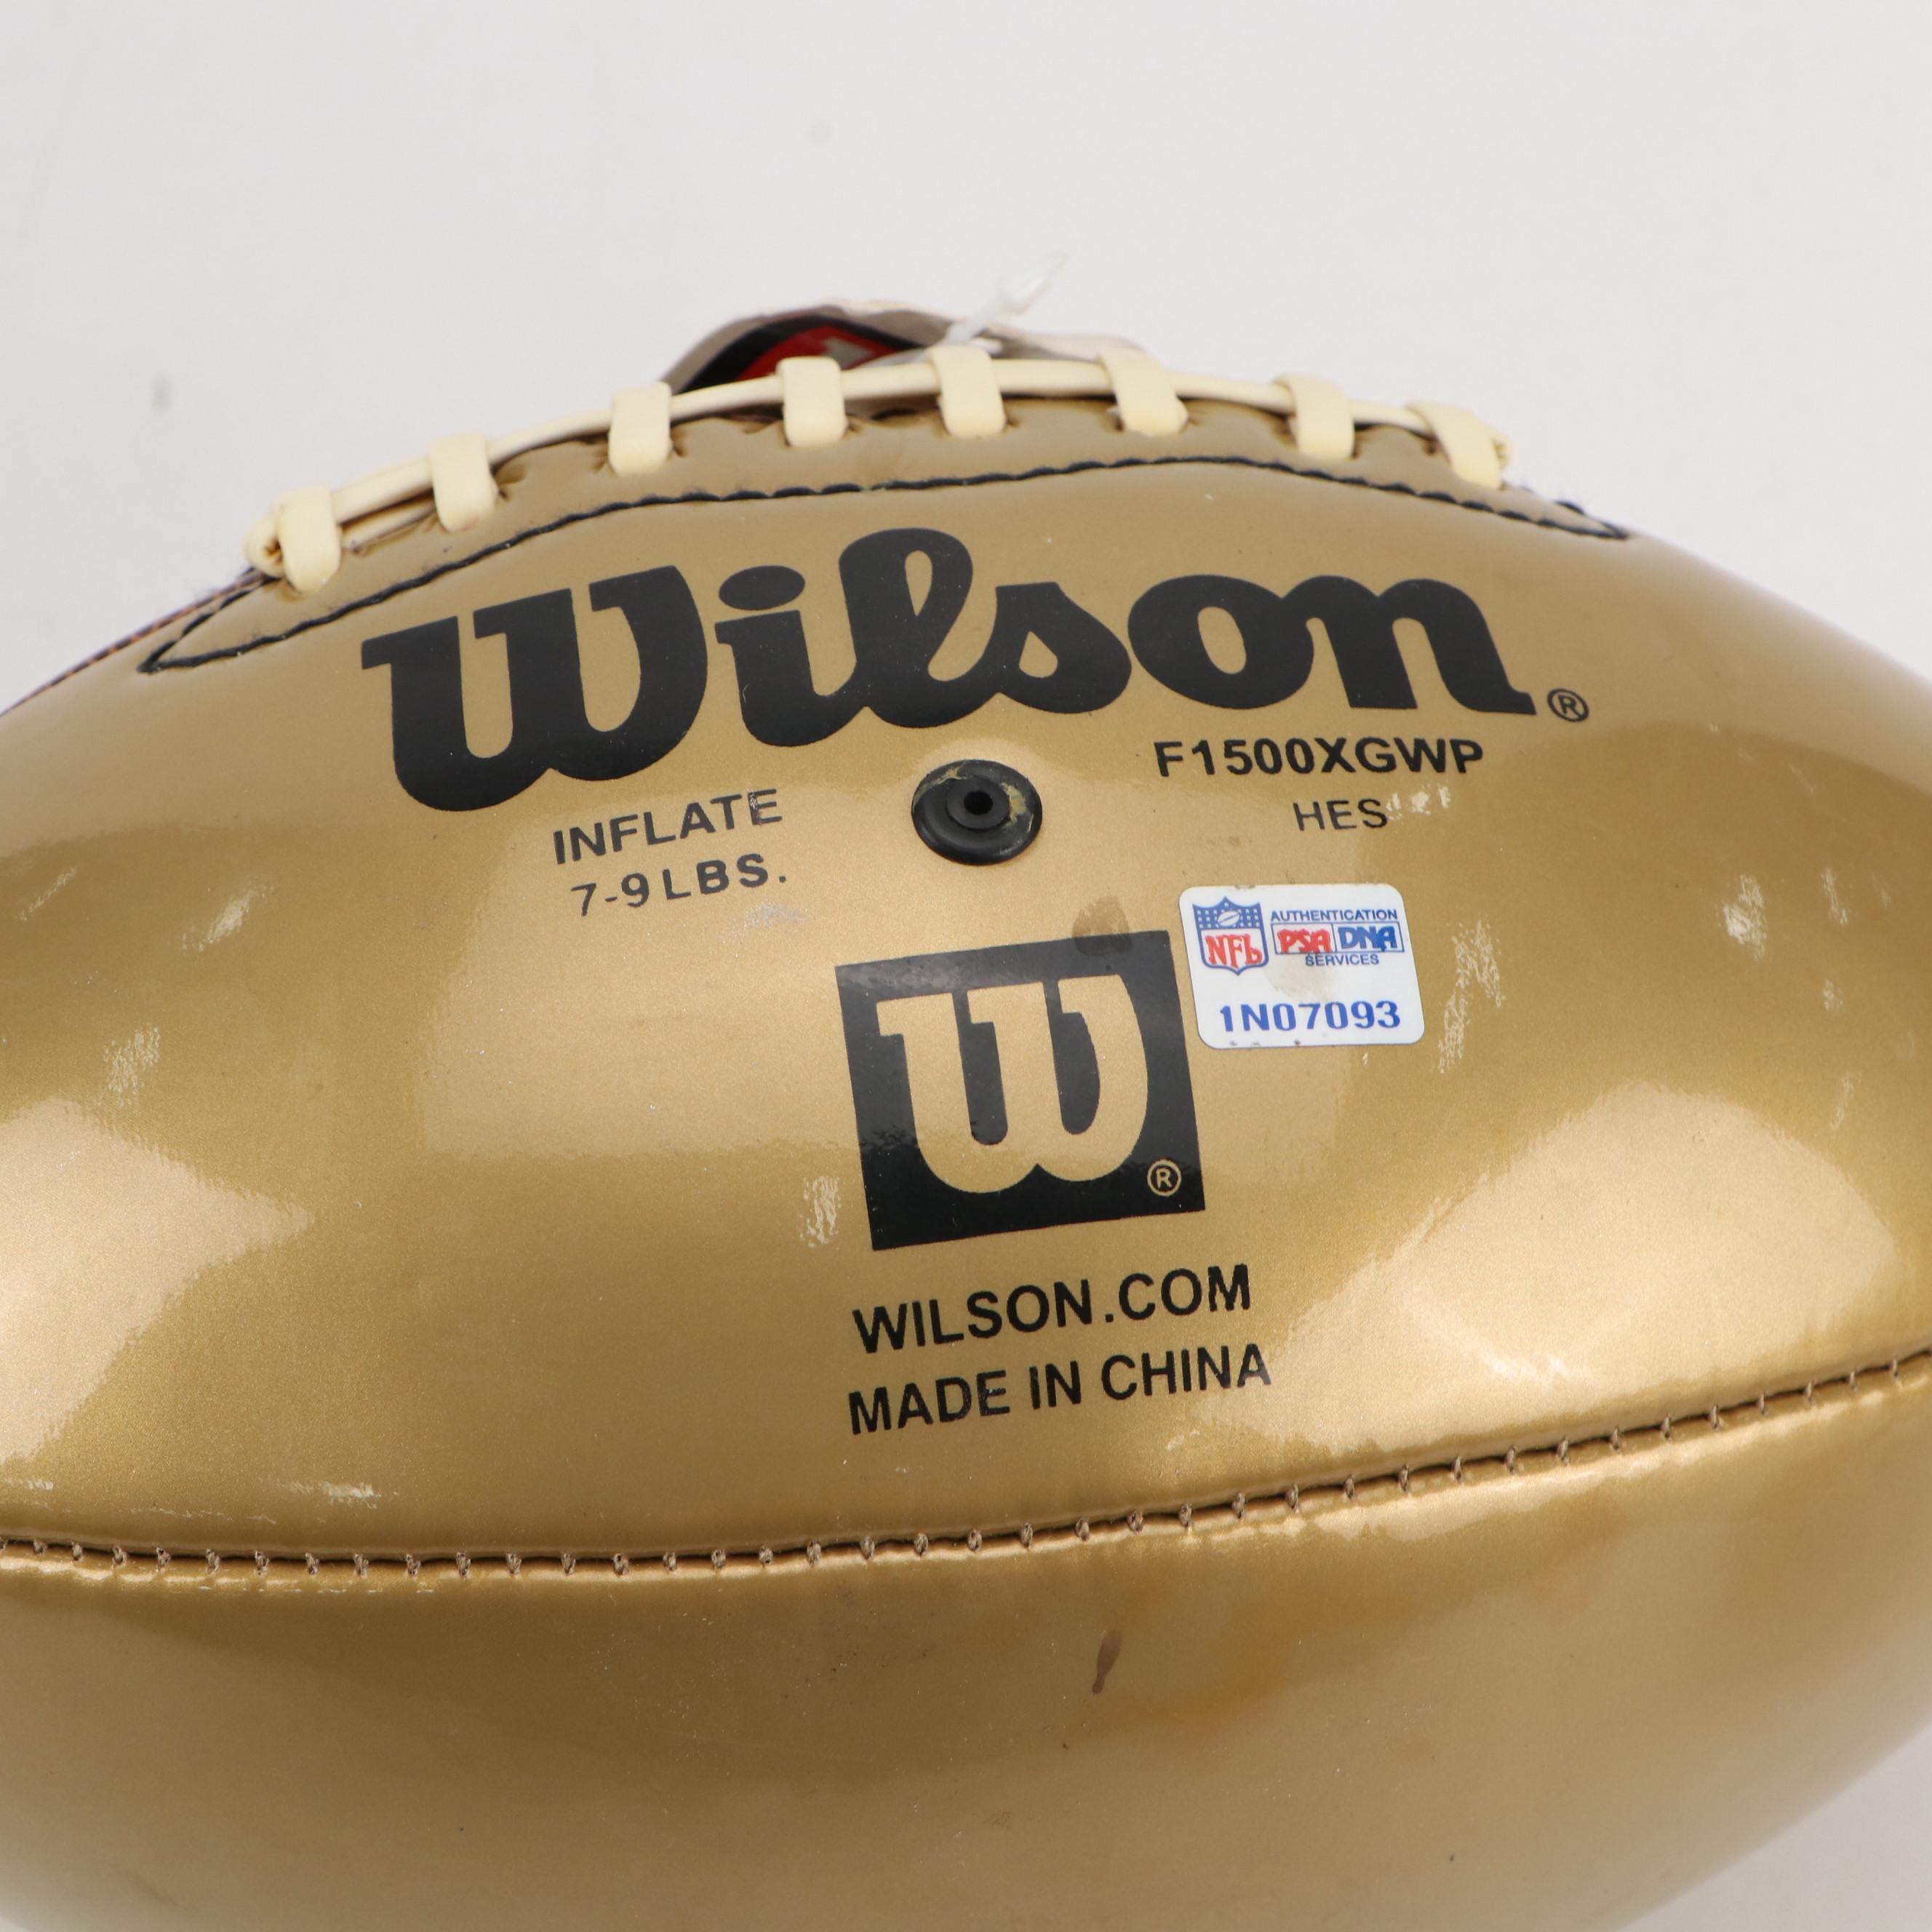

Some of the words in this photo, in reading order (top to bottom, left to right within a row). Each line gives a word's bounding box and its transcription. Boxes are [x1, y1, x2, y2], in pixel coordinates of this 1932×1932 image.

[362, 527, 1535, 811] Wilson
[1154, 736, 1484, 777] F1500XGWP
[553, 789, 783, 865] INFLATE
[1293, 799, 1389, 831] HES
[1271, 909, 1398, 922] AUTHENTICATION
[1205, 933, 1263, 969] NFL
[1277, 928, 1333, 954] PSA
[1338, 926, 1397, 952] DNA
[1305, 954, 1380, 967] SERVICES
[1220, 1000, 1401, 1032] 1N07093
[876, 974, 1148, 1194] W
[852, 1264, 1251, 1354] WILSON.COM
[848, 1370, 1010, 1435] MADE
[1029, 1360, 1082, 1410] IN
[1101, 1344, 1272, 1400] CHINA
